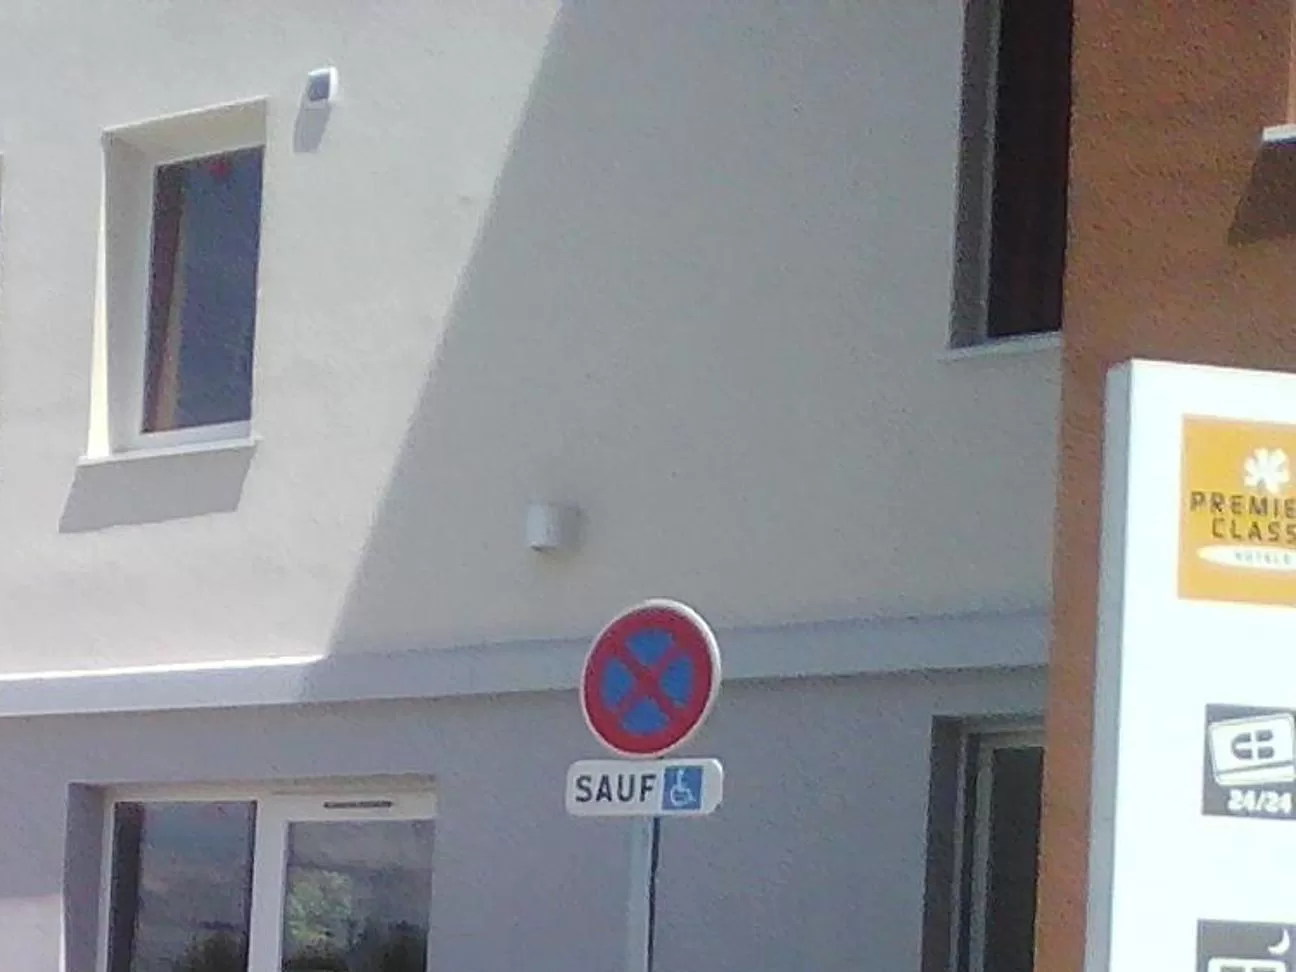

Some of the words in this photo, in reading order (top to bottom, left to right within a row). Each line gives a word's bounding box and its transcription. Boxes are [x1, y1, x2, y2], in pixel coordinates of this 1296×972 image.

[1212, 517, 1296, 544] CLASS
[575, 774, 656, 802] SAUF
[1227, 789, 1292, 814] 24/24
